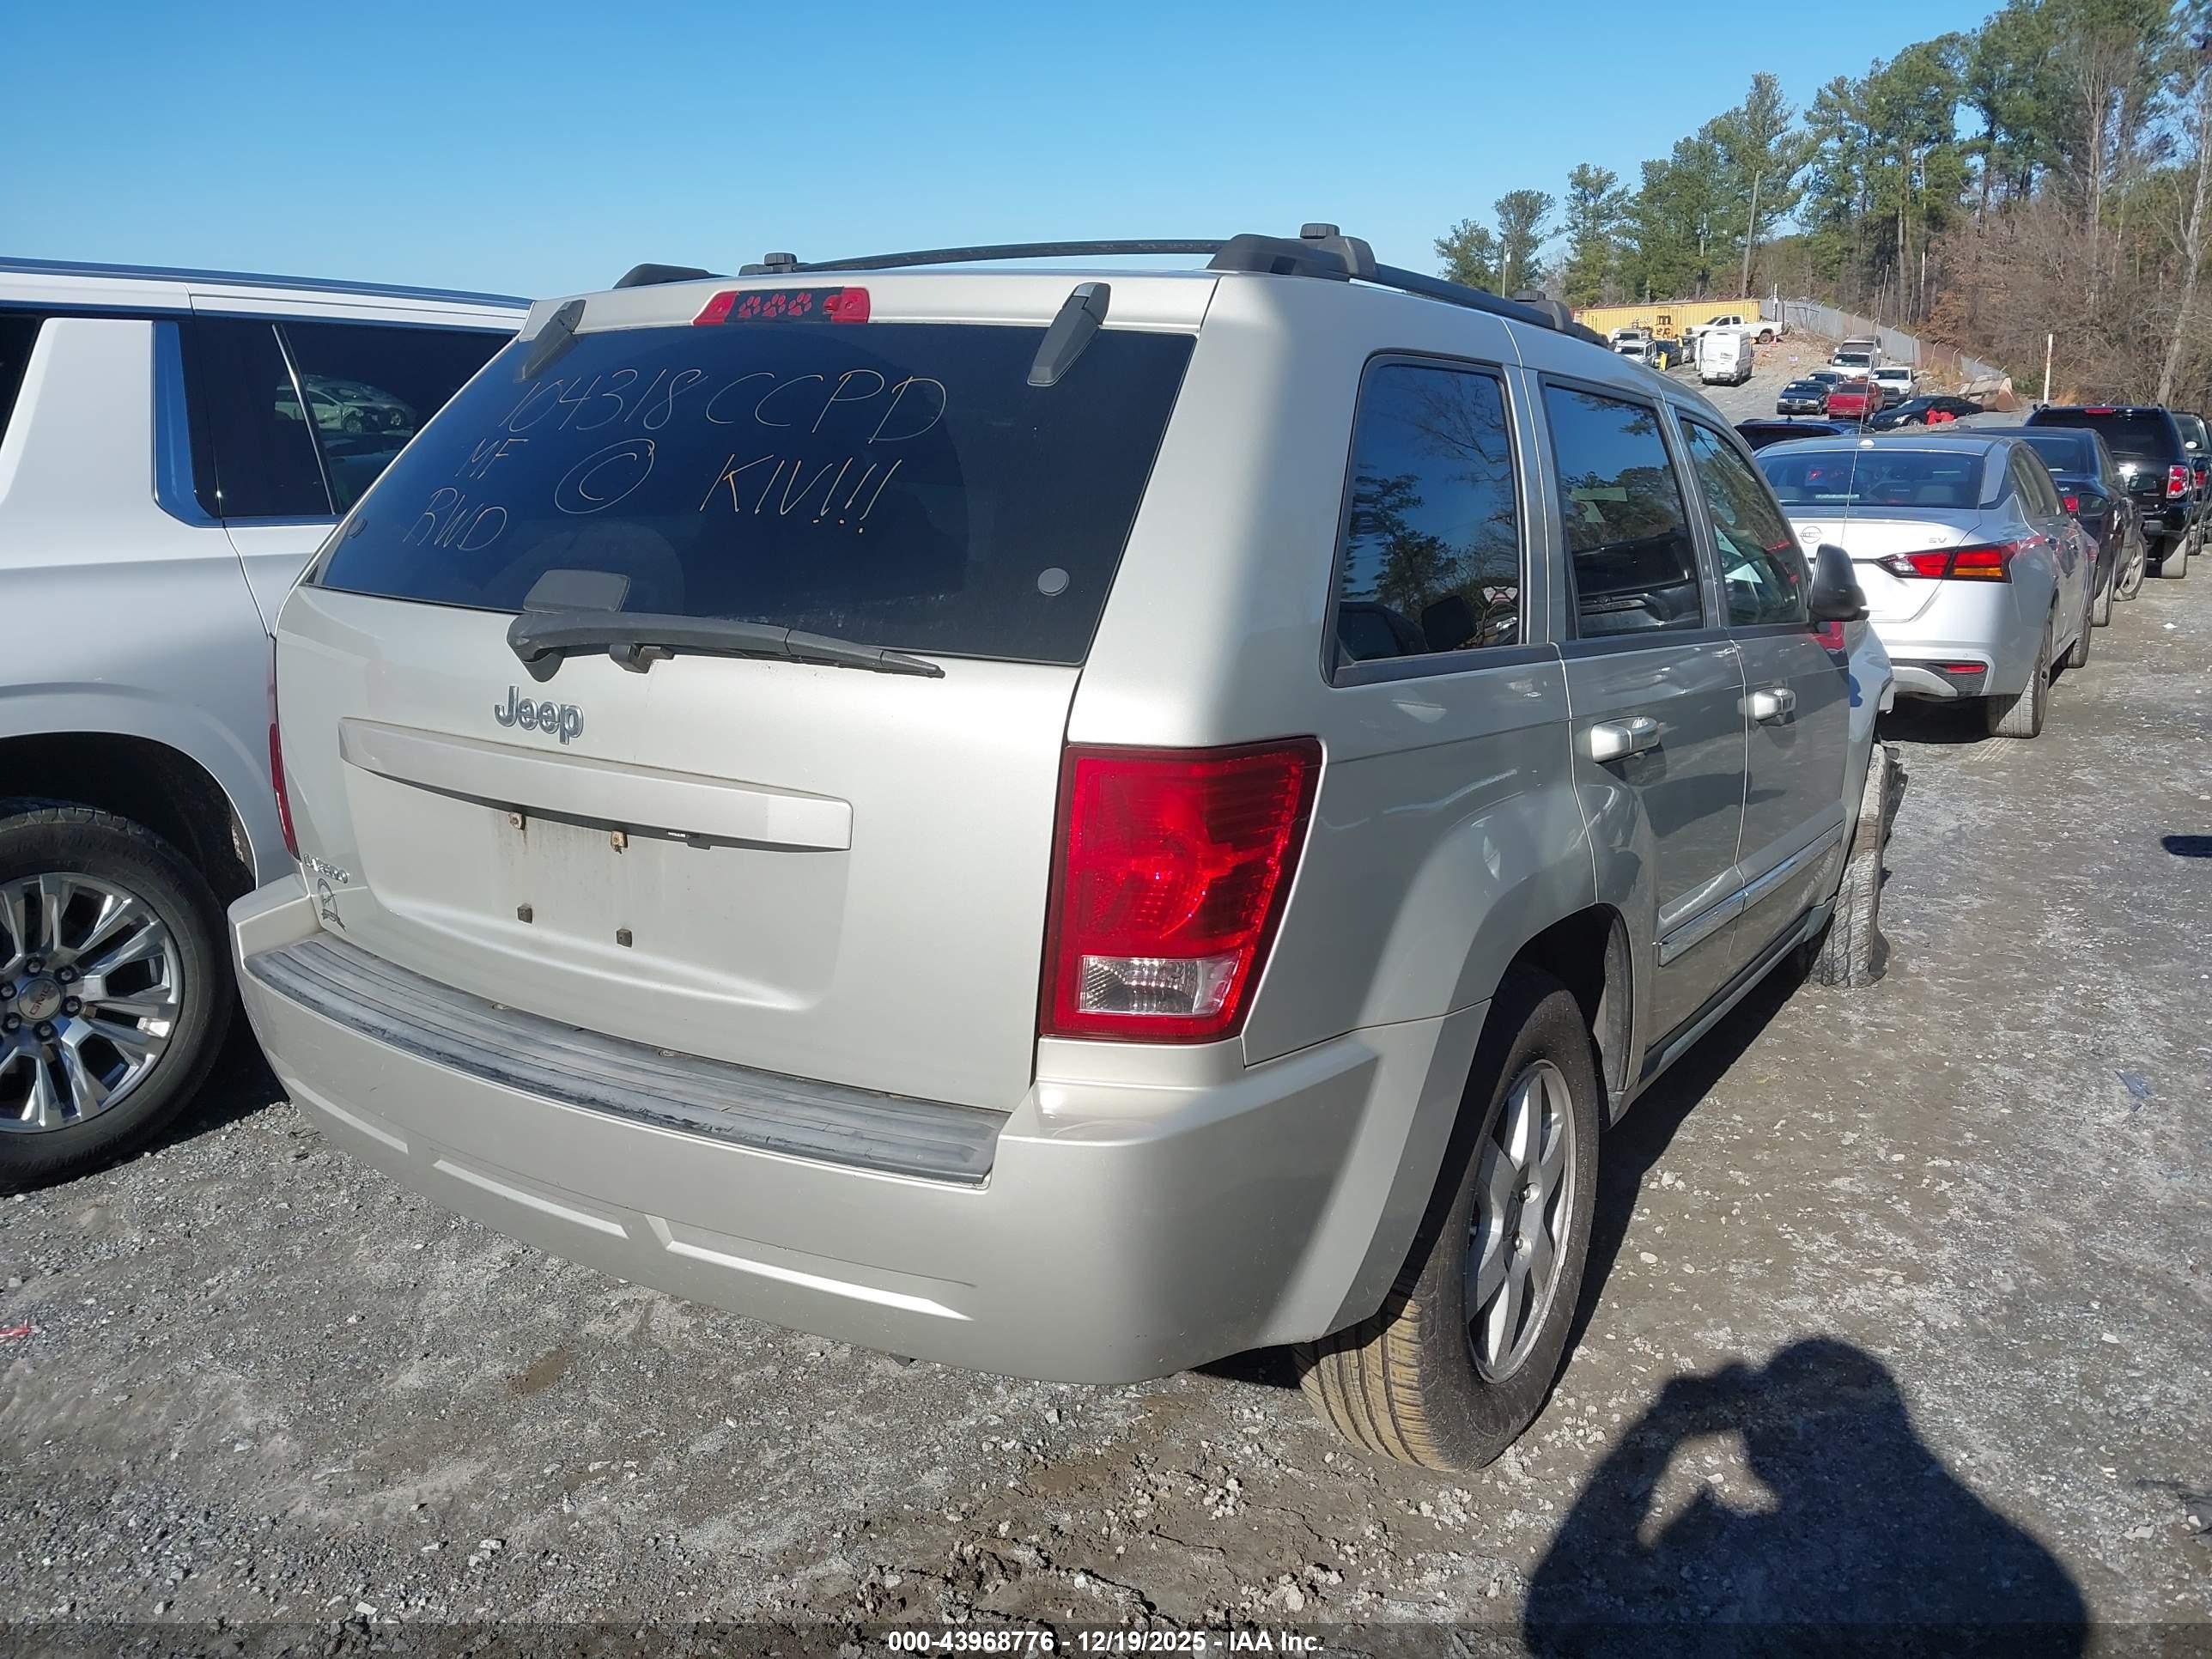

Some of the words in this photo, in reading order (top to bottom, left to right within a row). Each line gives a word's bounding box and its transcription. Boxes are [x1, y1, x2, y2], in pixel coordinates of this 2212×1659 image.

[498, 368, 708, 433] 104318
[706, 369, 946, 444] CCPD
[454, 438, 529, 479] MF
[403, 487, 507, 551] RWD
[494, 686, 584, 745] Jeep
